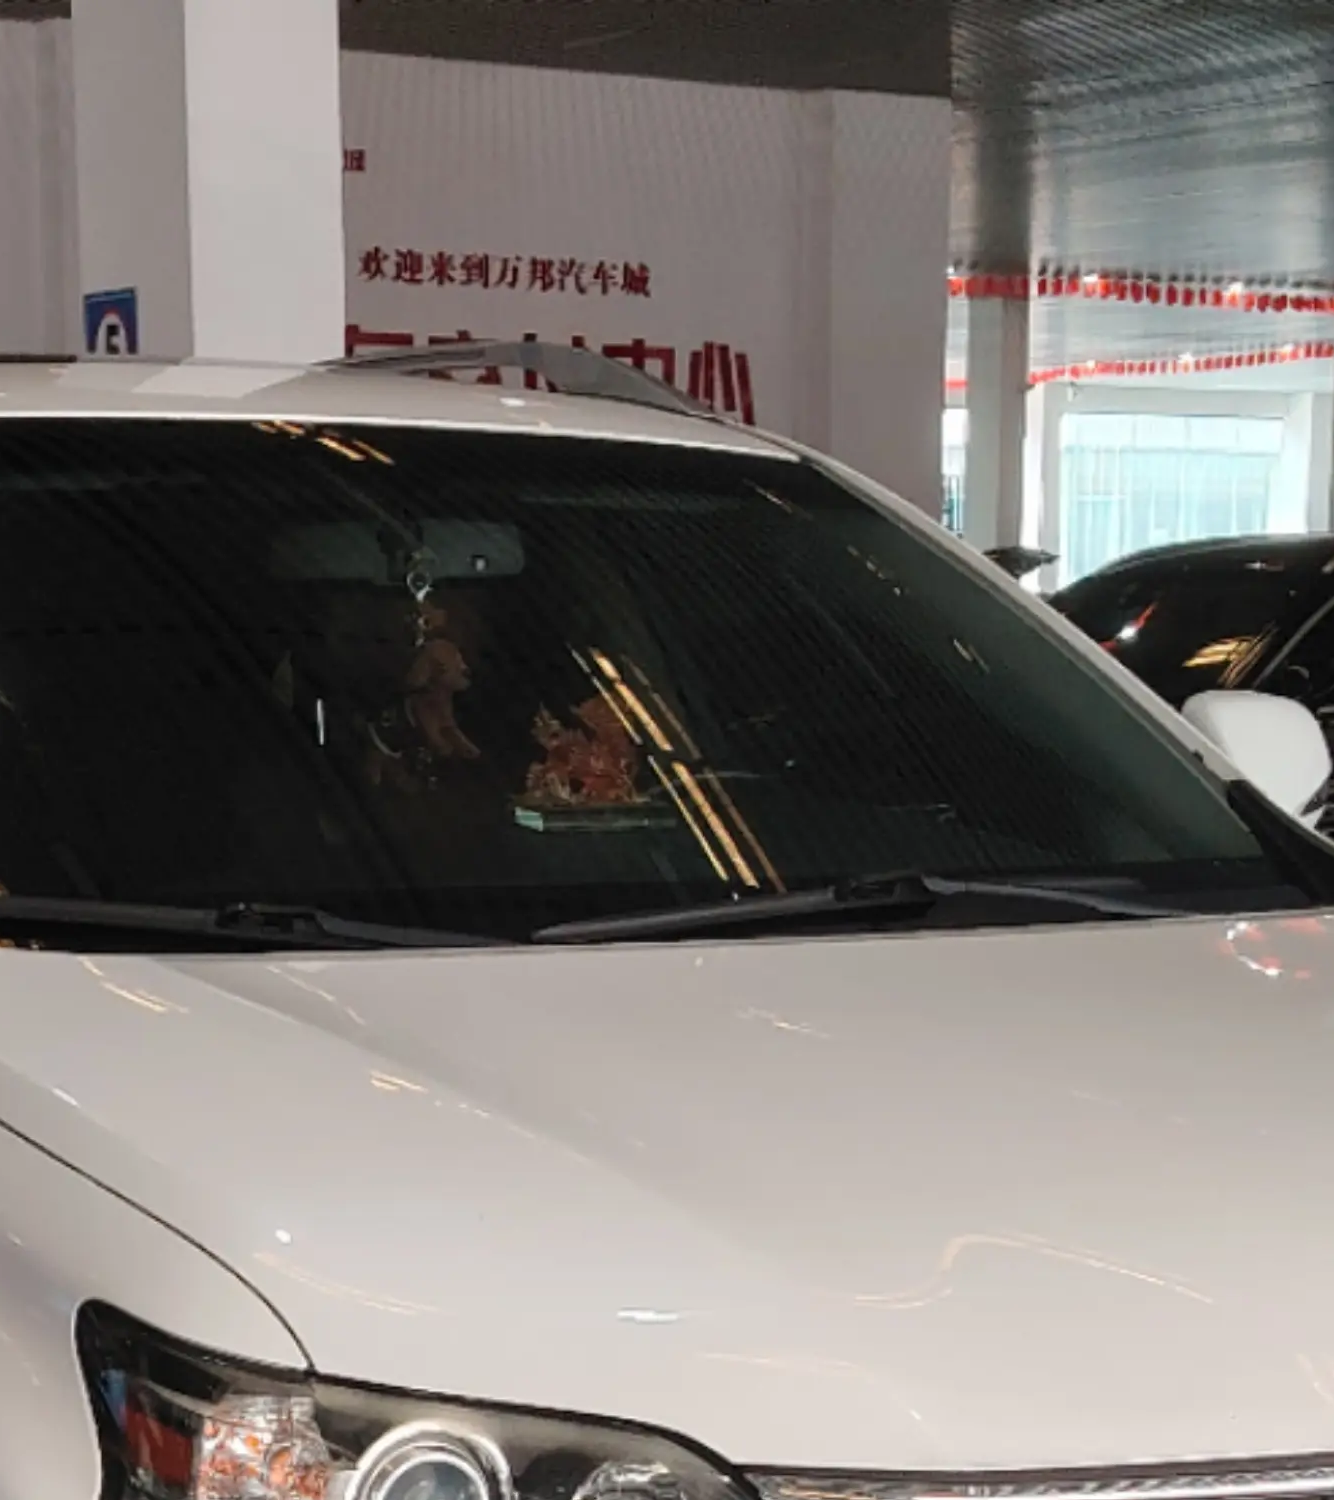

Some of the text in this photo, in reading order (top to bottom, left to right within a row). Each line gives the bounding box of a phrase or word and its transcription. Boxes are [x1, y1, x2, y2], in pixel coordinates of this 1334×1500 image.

[358, 246, 651, 298] 欢迎来到万邦汽车城
